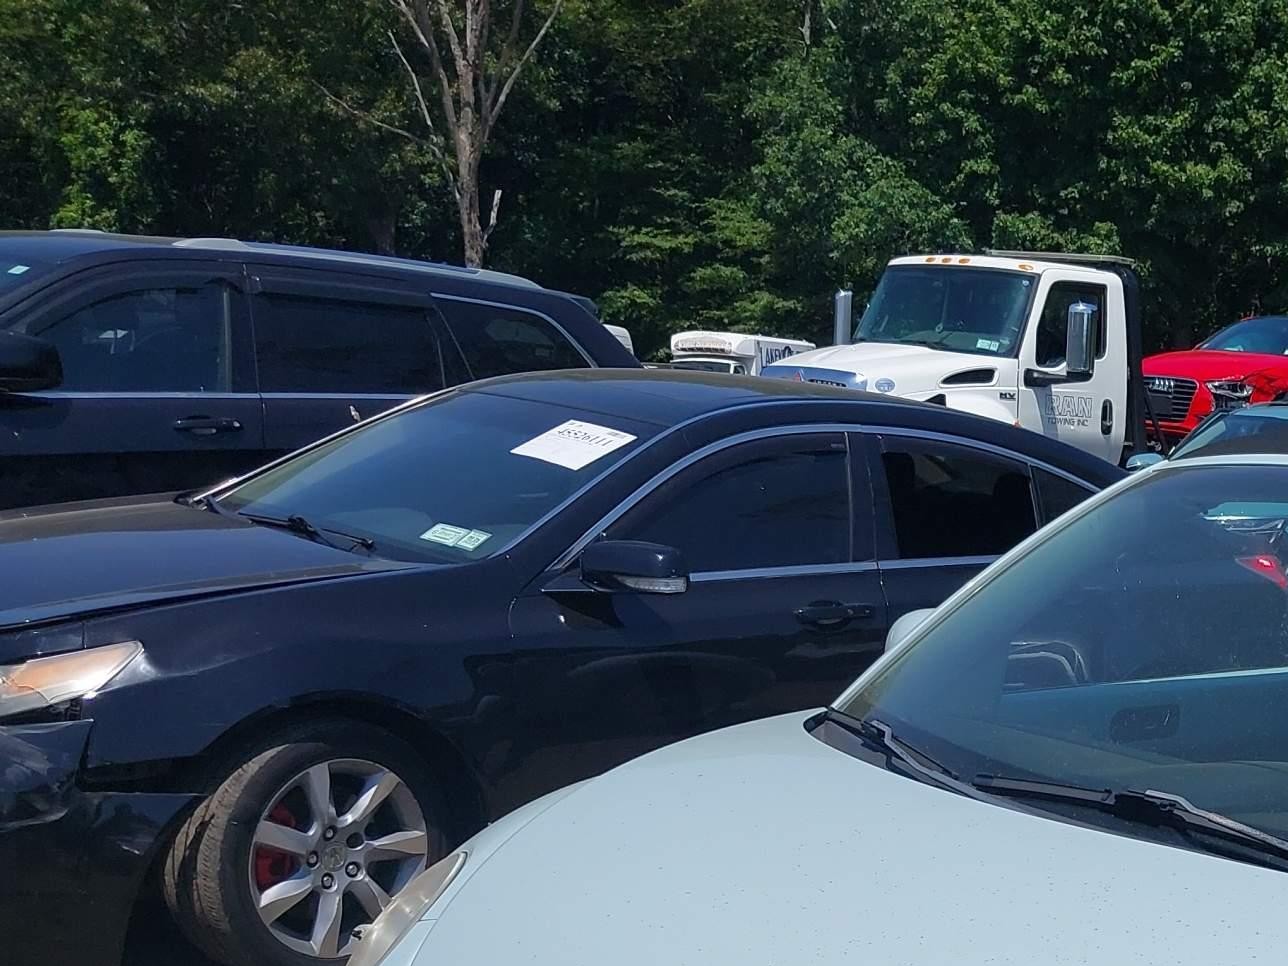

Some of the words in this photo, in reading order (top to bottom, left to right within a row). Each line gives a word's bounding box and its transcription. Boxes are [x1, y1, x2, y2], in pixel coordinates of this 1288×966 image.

[1045, 394, 1093, 418] RAN
[1047, 417, 1075, 426] TOWING
[1076, 419, 1089, 427] INC
